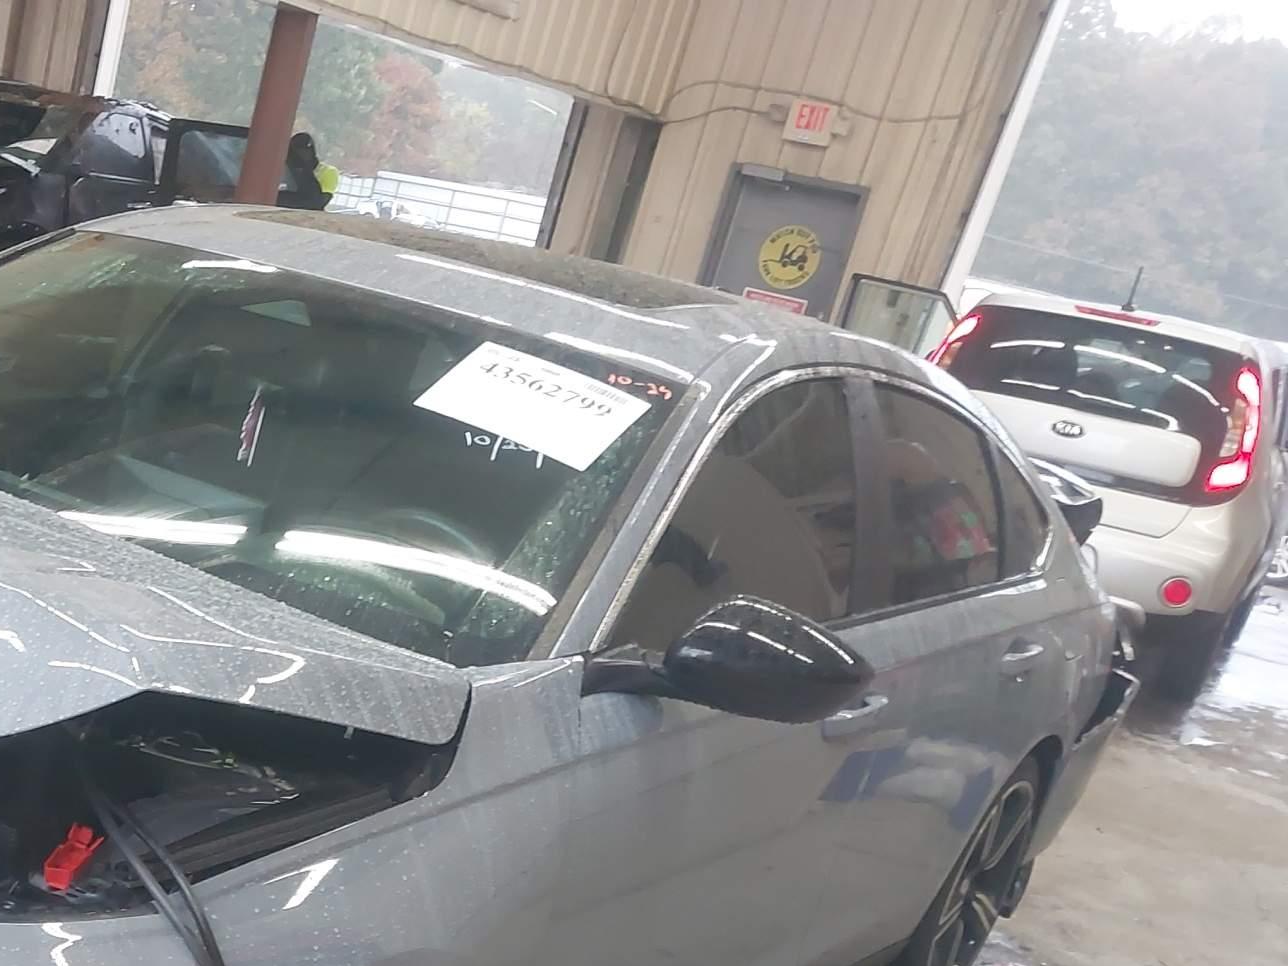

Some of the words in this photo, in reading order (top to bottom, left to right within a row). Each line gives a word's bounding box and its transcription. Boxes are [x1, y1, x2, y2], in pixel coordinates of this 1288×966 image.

[794, 103, 830, 132] EXIT
[479, 362, 613, 416] 43562799
[1055, 421, 1082, 436] KIA
